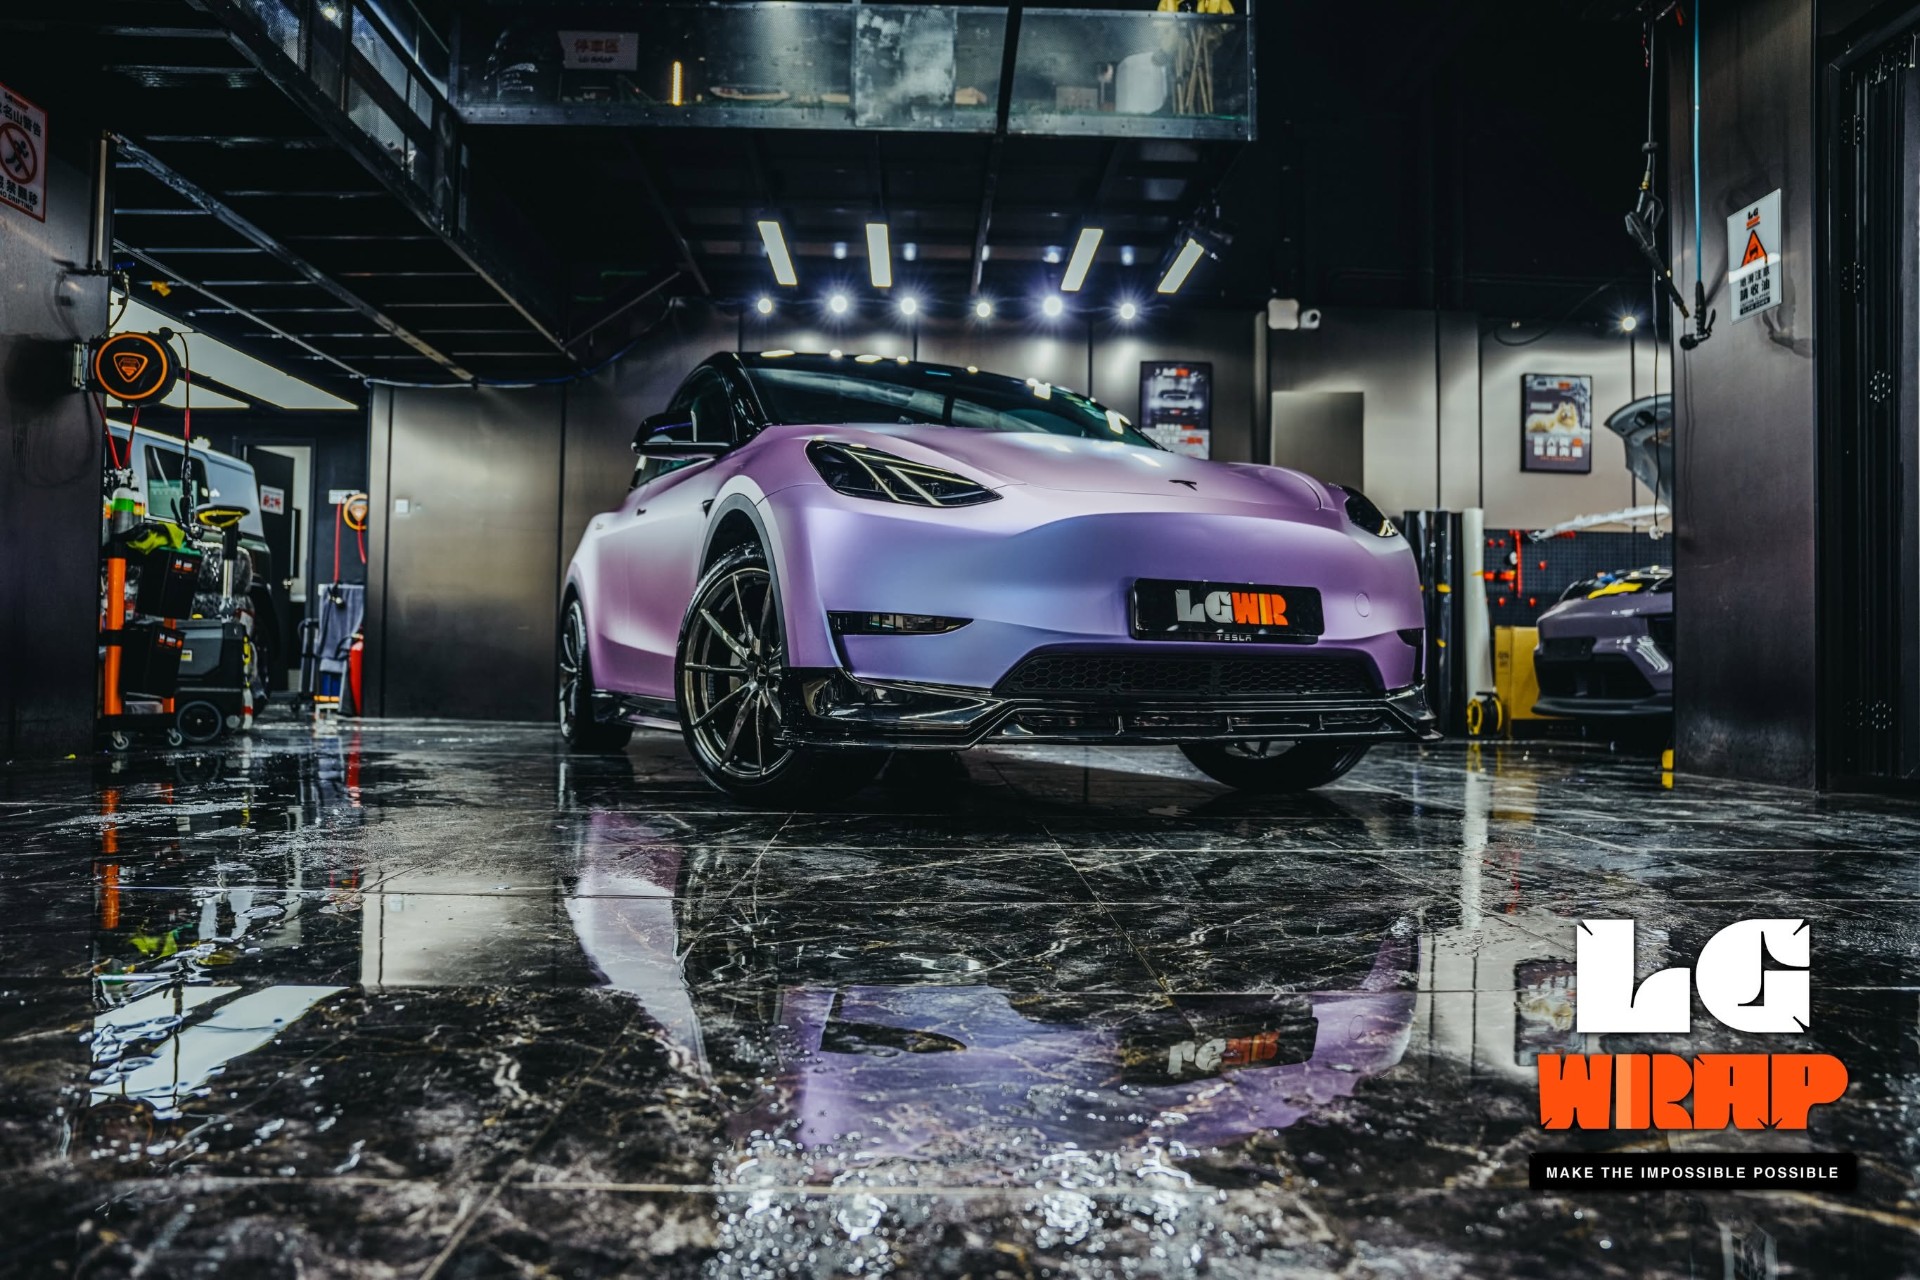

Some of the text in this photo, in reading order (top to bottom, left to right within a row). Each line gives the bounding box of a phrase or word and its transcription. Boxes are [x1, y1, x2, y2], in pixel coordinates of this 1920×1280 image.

[0, 101, 42, 138] 名山警告
[1216, 633, 1252, 642] TESLA
